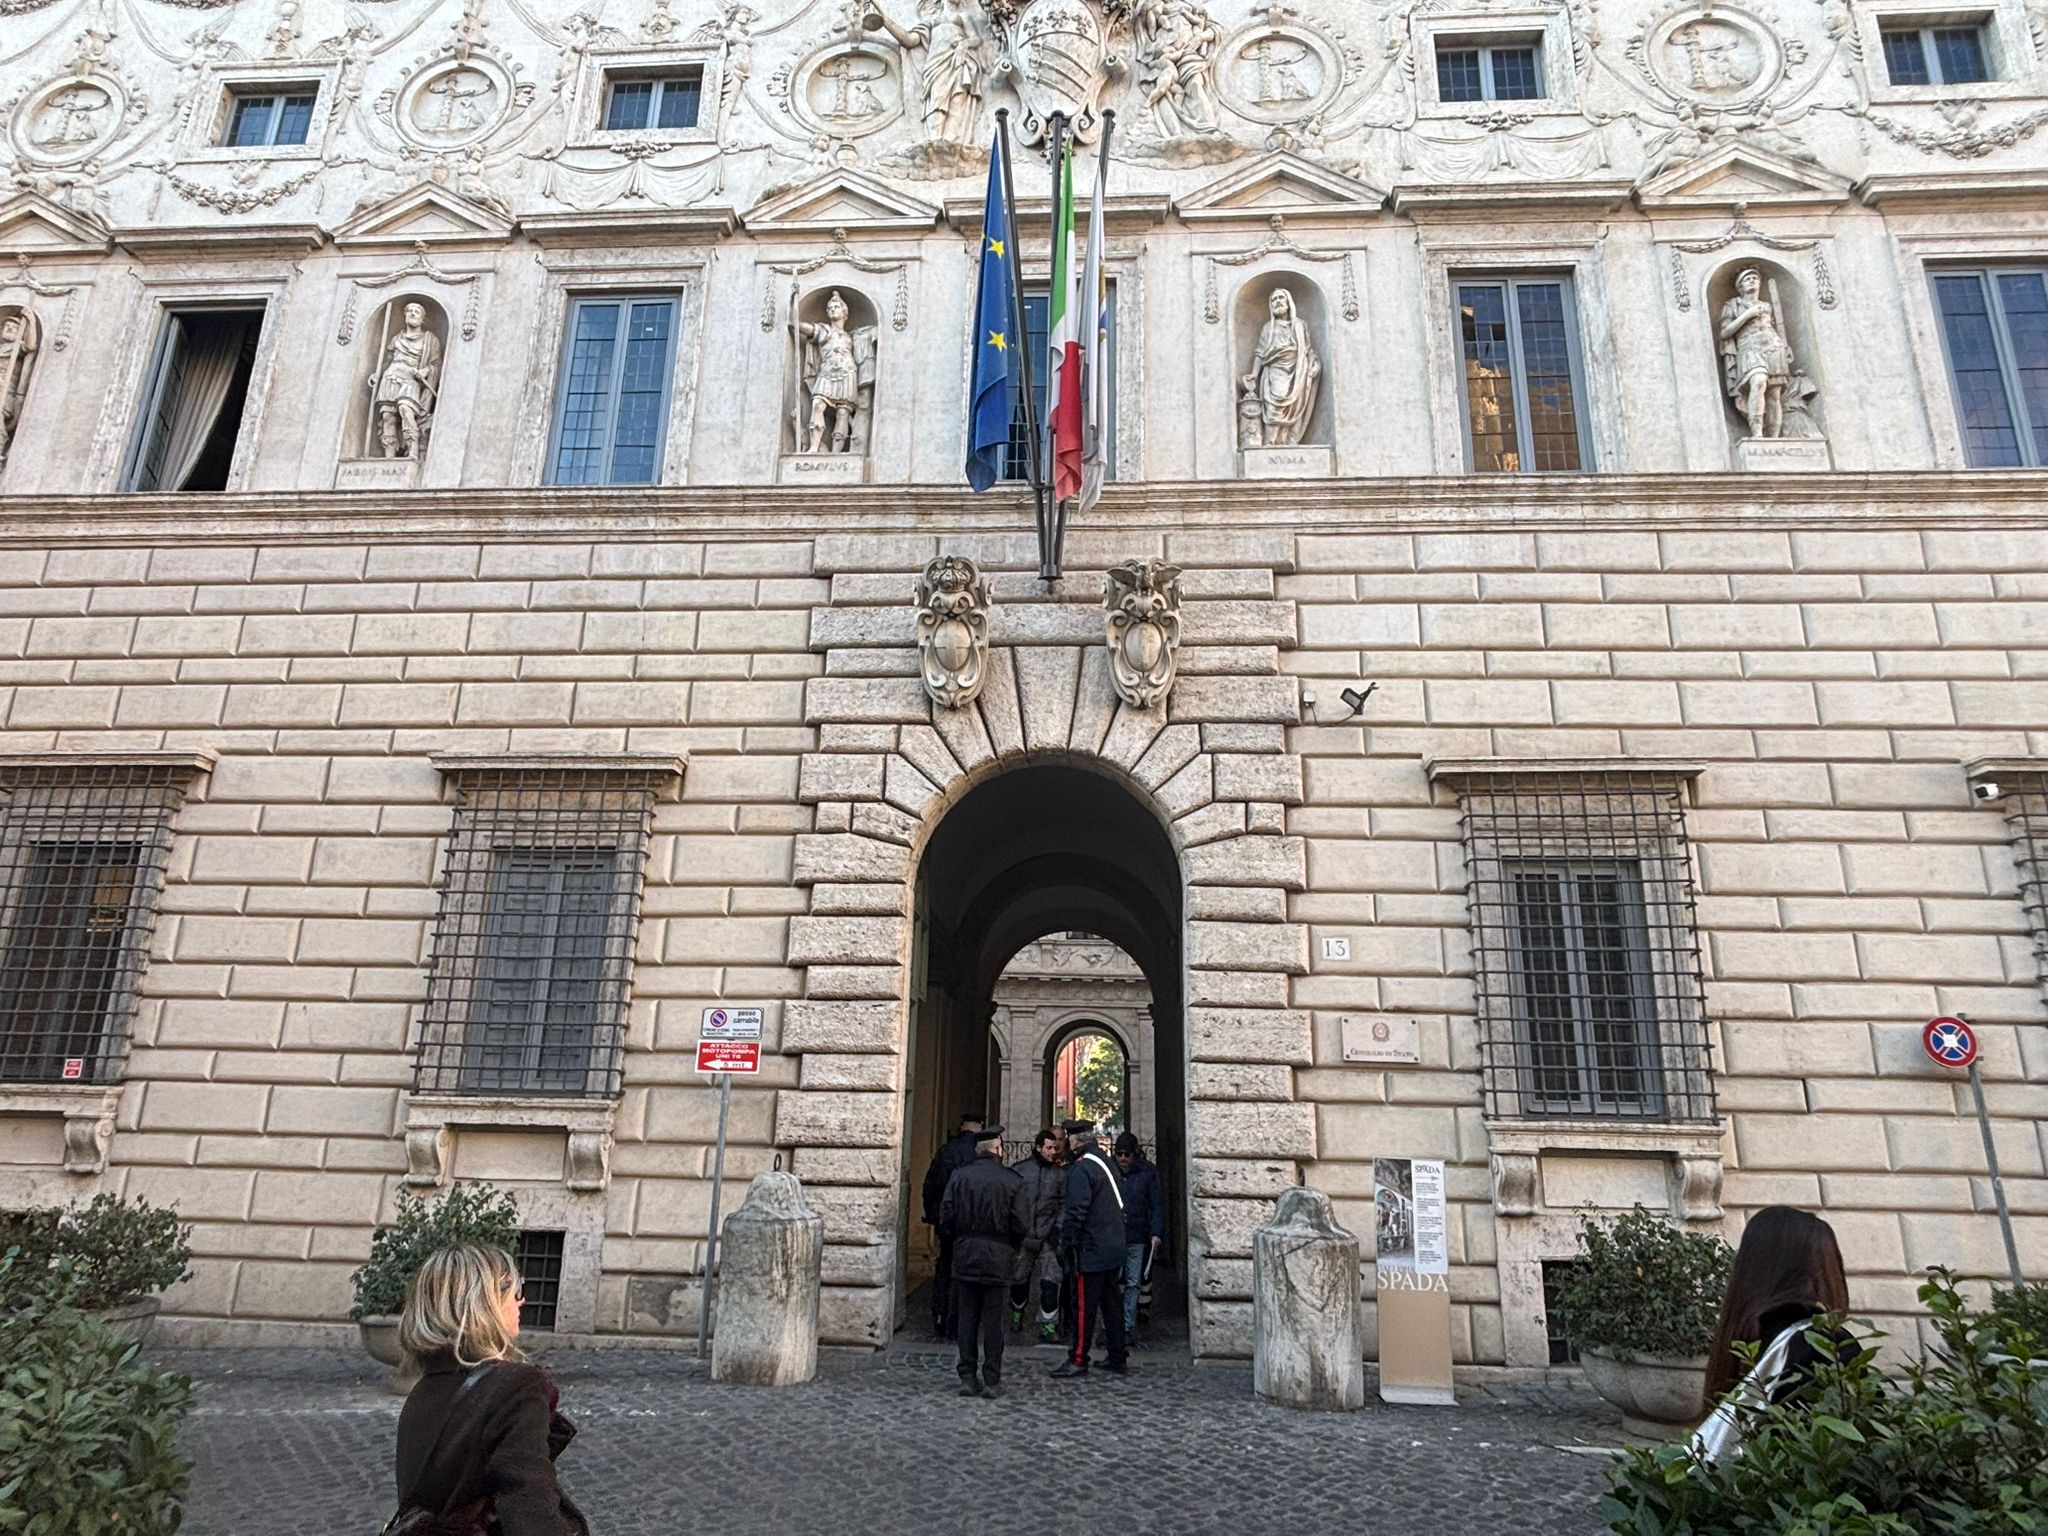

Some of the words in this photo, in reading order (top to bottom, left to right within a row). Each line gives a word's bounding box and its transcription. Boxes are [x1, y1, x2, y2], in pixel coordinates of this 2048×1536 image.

[1325, 940, 1346, 957] 13
[1414, 1165, 1441, 1174] SPADA
[1377, 1271, 1448, 1292] SPADA
